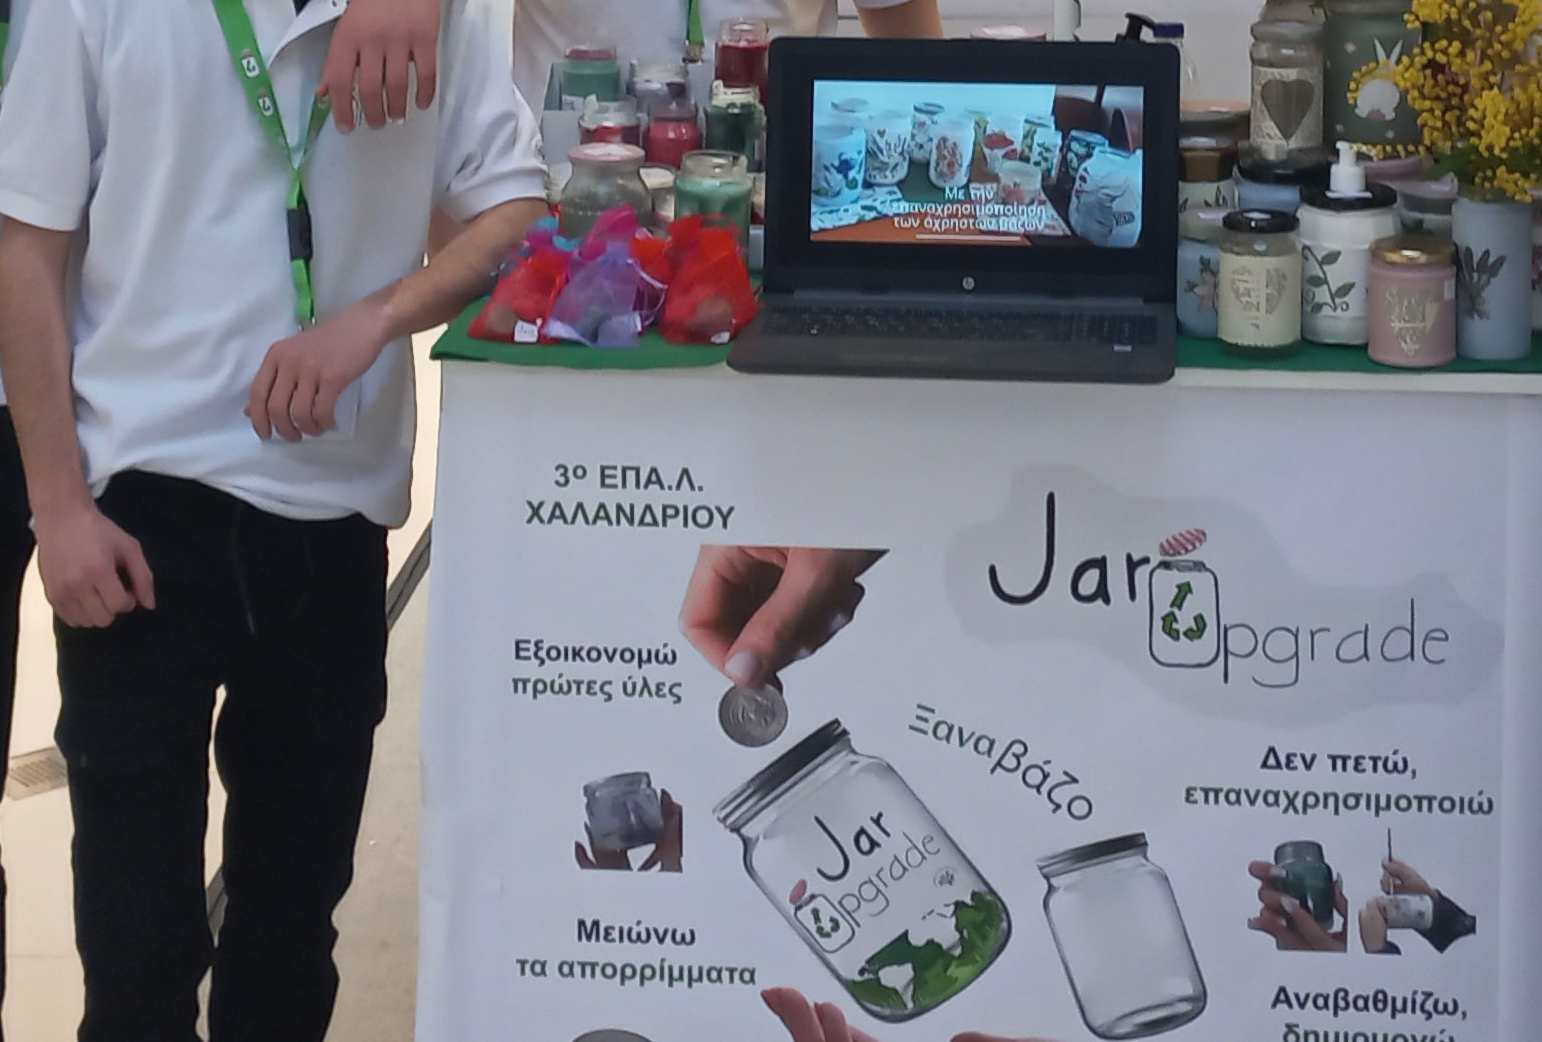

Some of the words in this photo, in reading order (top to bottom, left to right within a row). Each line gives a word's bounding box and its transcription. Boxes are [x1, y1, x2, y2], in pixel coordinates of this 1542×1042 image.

[600, 465, 705, 492] ΕΠΑ.Λ.
[525, 500, 736, 530] ΧΑΛΑΝΔΡΙΟΥ
[988, 491, 1152, 607] Jar
[514, 639, 678, 667] Εξοικονομώ
[512, 675, 613, 702] πρώτες
[622, 676, 683, 704] ύλες
[908, 703, 1093, 821] Ξαναβάζο
[1260, 745, 1316, 774] Δεν
[1325, 746, 1418, 780] πετώ,
[1183, 783, 1495, 819] επαναχρησιμοποιώ
[813, 811, 892, 882] Jar
[576, 919, 697, 946] Μειώνω
[516, 959, 548, 978] τα
[557, 956, 757, 987] απορρίμματα
[1270, 985, 1468, 1021] Αναβαθμίζω,
